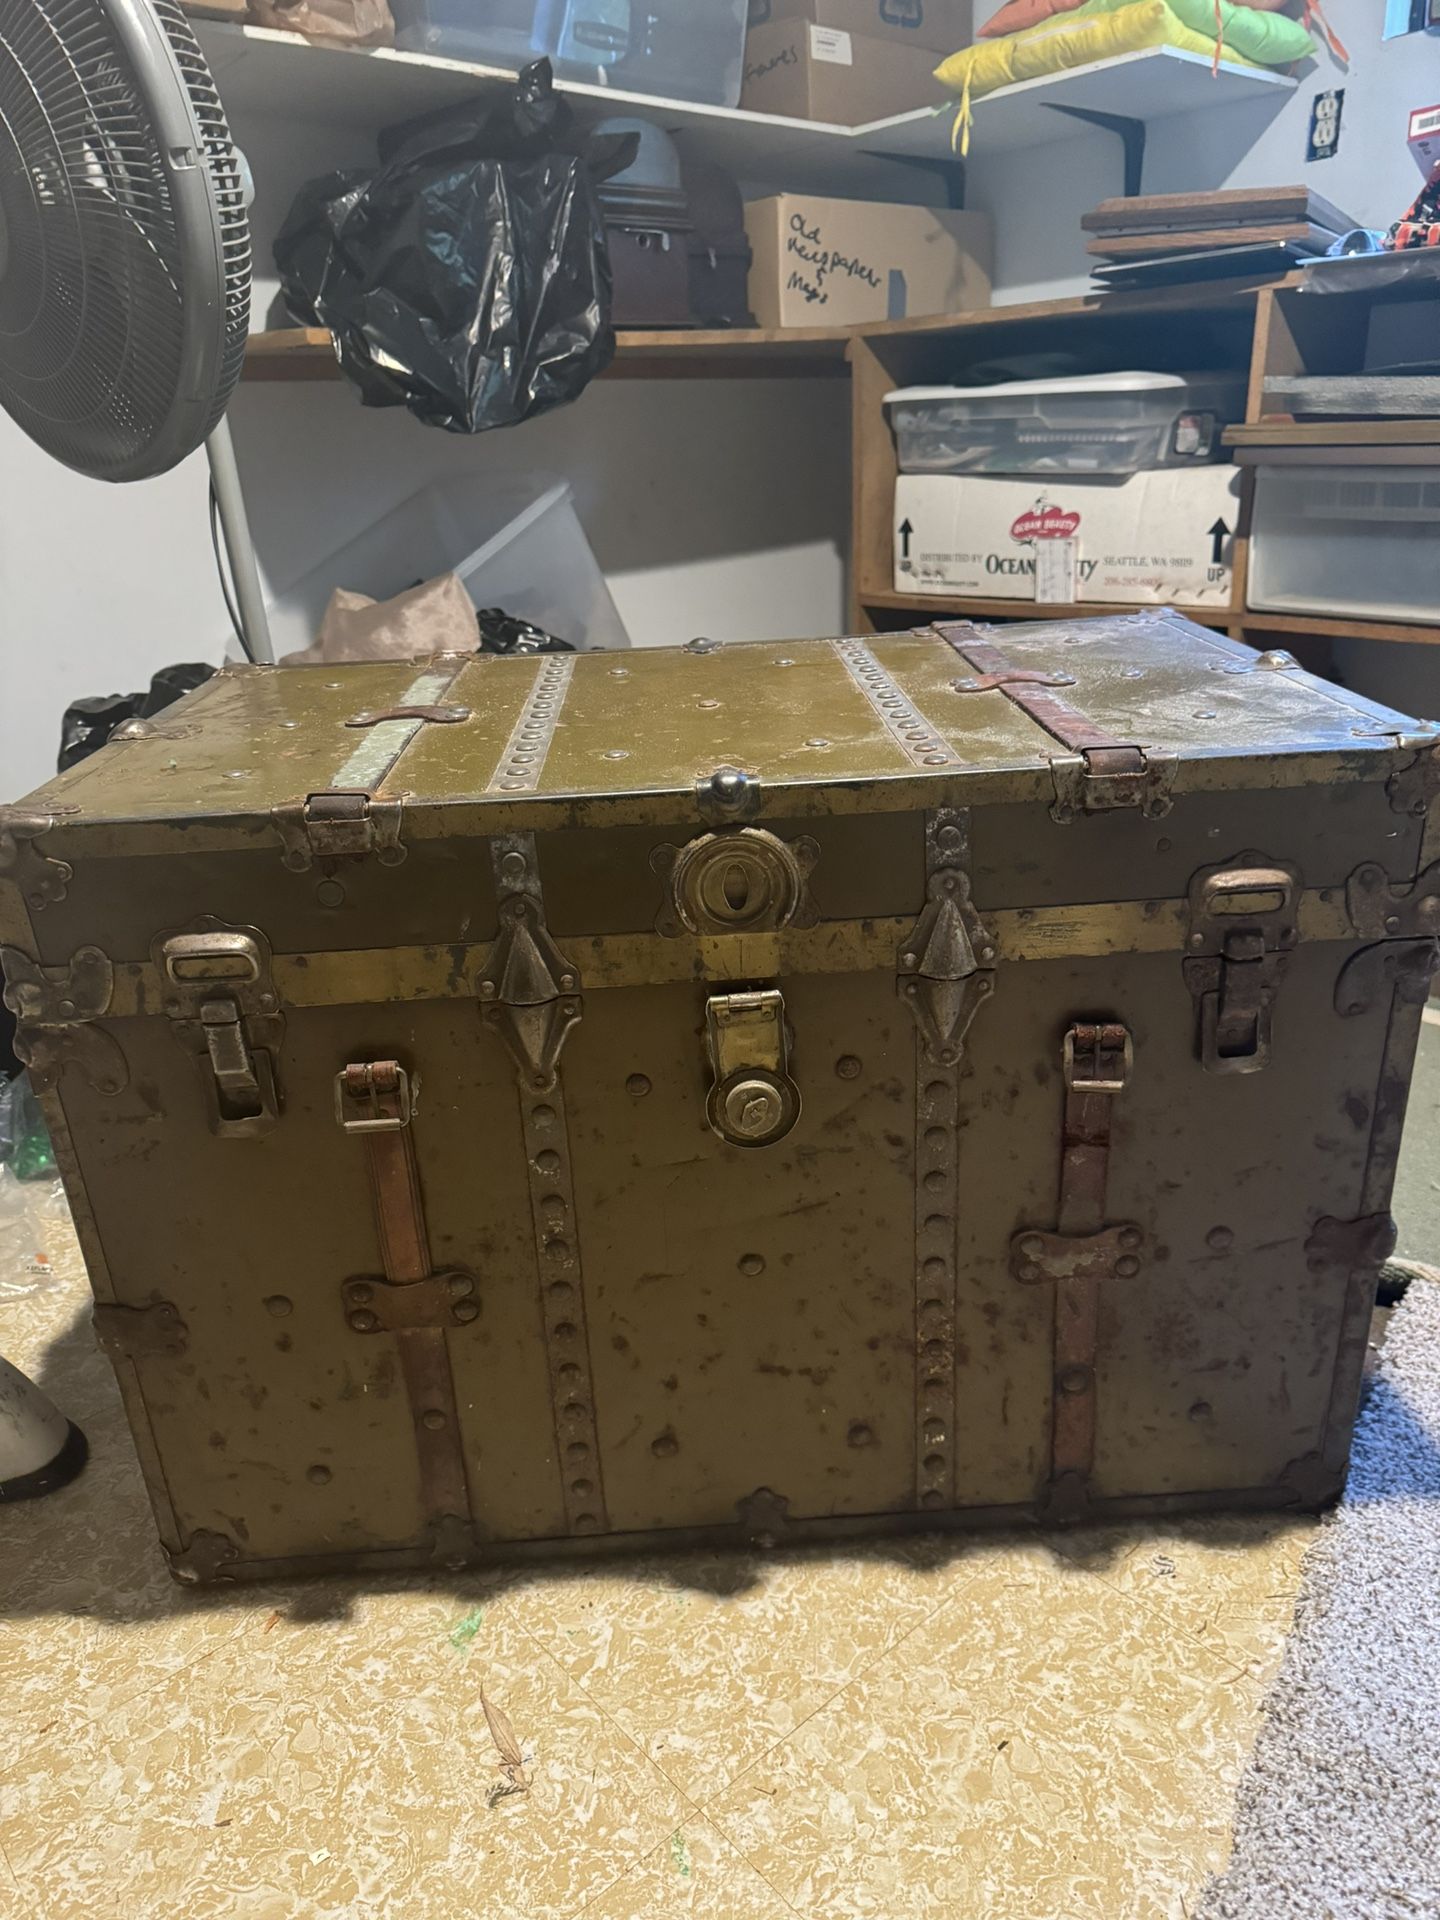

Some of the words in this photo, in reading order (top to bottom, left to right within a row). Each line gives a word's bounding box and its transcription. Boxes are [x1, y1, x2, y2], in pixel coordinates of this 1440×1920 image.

[790, 213, 821, 244] Old
[1151, 557, 1167, 567] WA
[1207, 568, 1225, 582] UP
